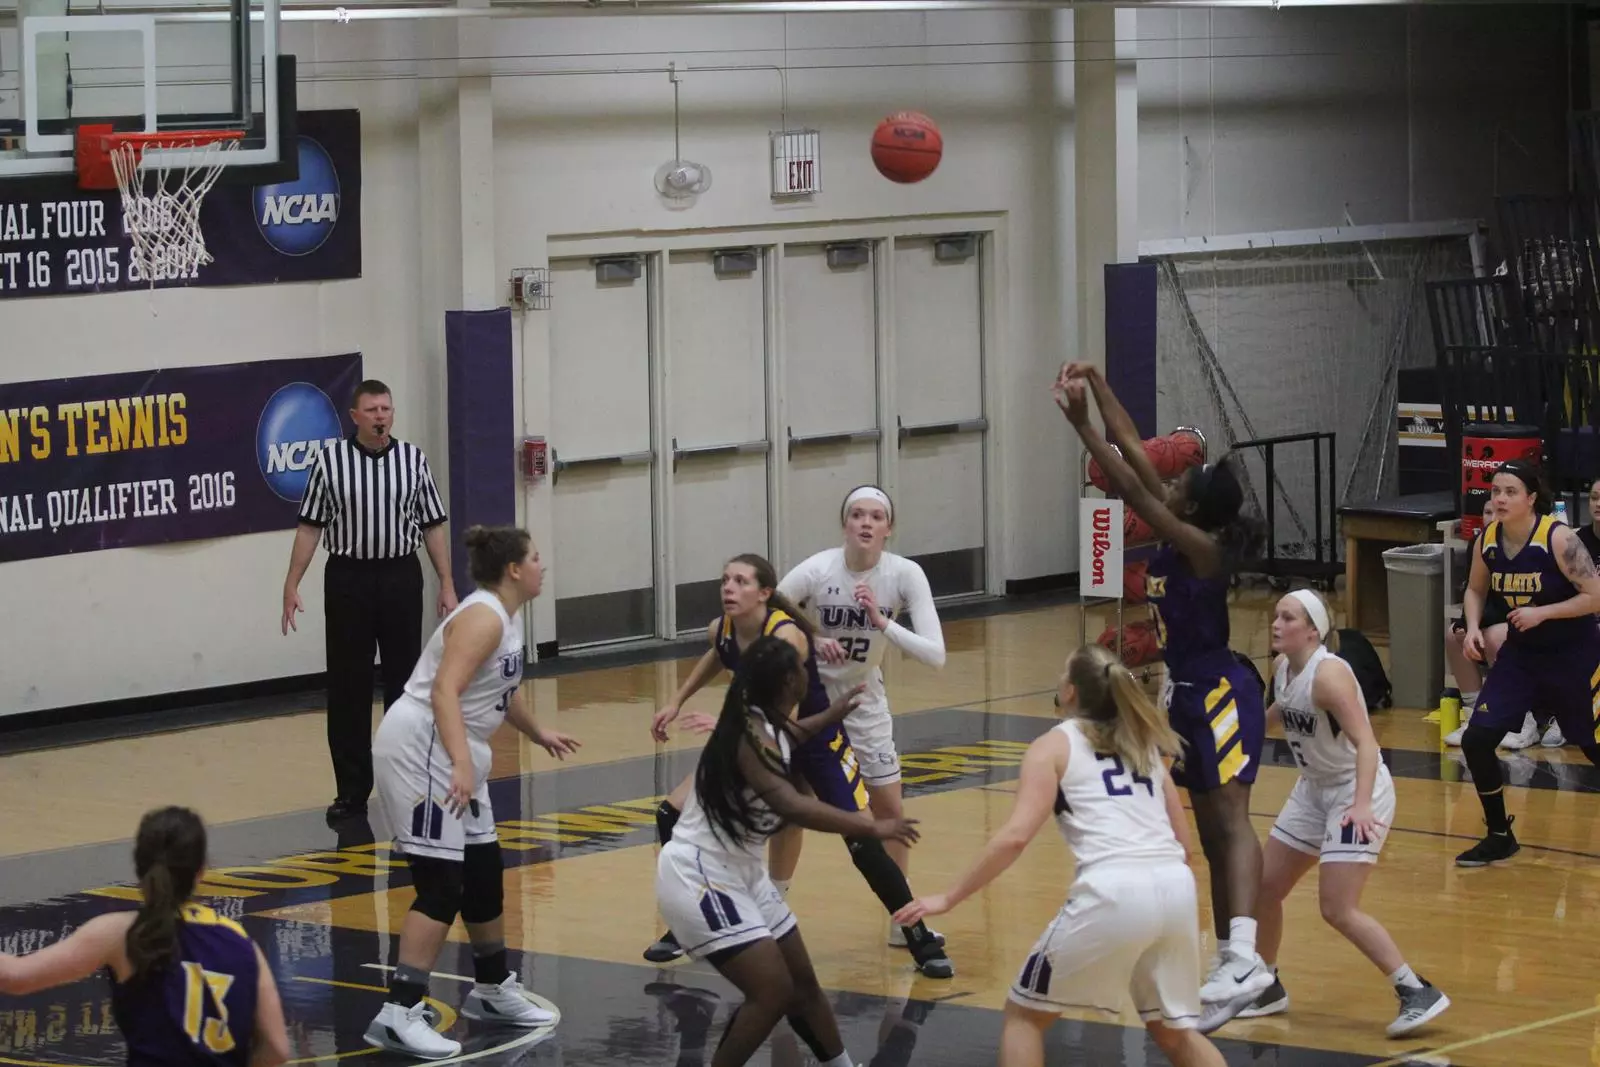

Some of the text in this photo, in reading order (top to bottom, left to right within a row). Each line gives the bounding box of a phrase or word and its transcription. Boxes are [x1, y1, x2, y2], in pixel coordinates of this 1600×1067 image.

[788, 160, 813, 190] EXIT
[0, 203, 36, 240] AL
[41, 200, 106, 239] FOUR
[262, 192, 338, 225] NCAA
[27, 250, 51, 288] 16
[66, 247, 120, 286] 2015
[58, 392, 188, 456] TENNIS
[267, 438, 338, 474] NCA
[47, 478, 178, 533] QUALIFIER
[189, 471, 236, 511] 2016
[1092, 507, 1111, 587] Wilson
[180, 961, 235, 1054] 13
